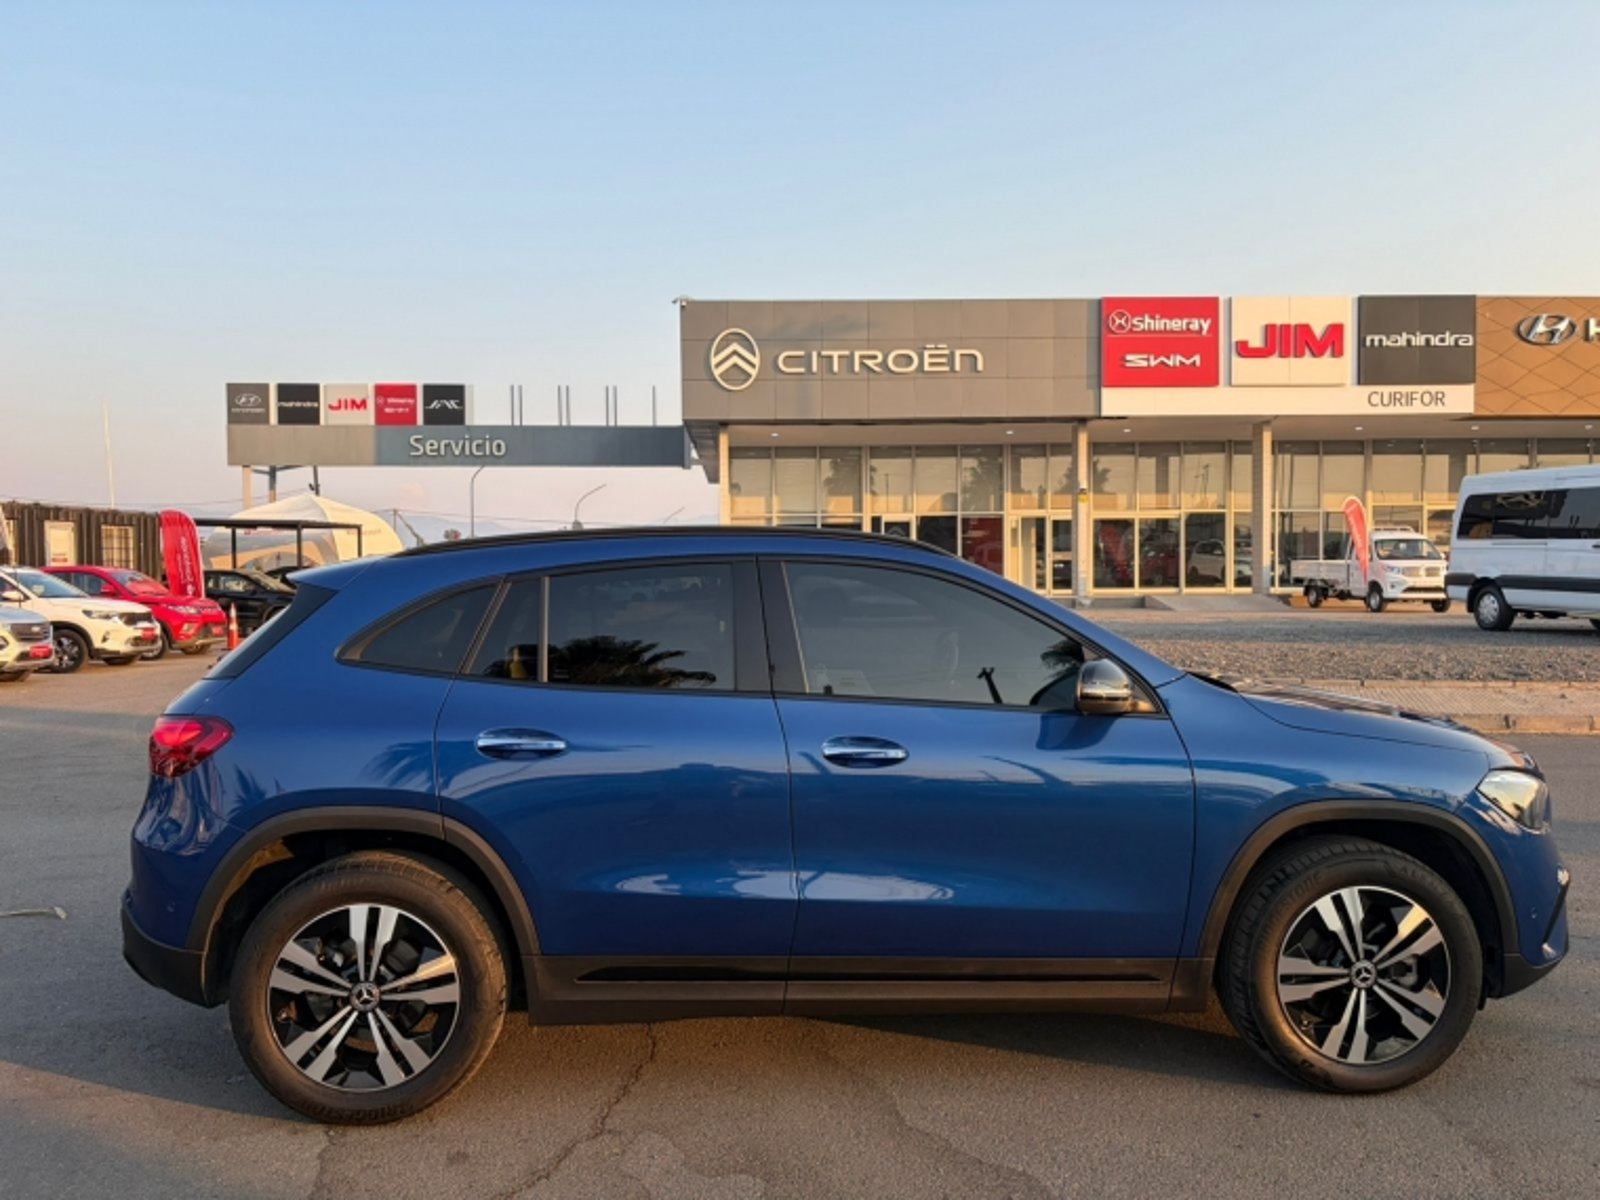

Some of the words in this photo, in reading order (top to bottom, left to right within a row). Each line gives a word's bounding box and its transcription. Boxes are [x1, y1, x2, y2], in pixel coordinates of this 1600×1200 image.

[1132, 313, 1212, 336] Shineray
[1234, 322, 1344, 358] JIM
[1364, 331, 1474, 347] mahindra
[1124, 353, 1201, 368] SWM
[328, 398, 368, 411] JIM
[1367, 390, 1447, 407] CURIFOR
[409, 434, 506, 456] Servicio
